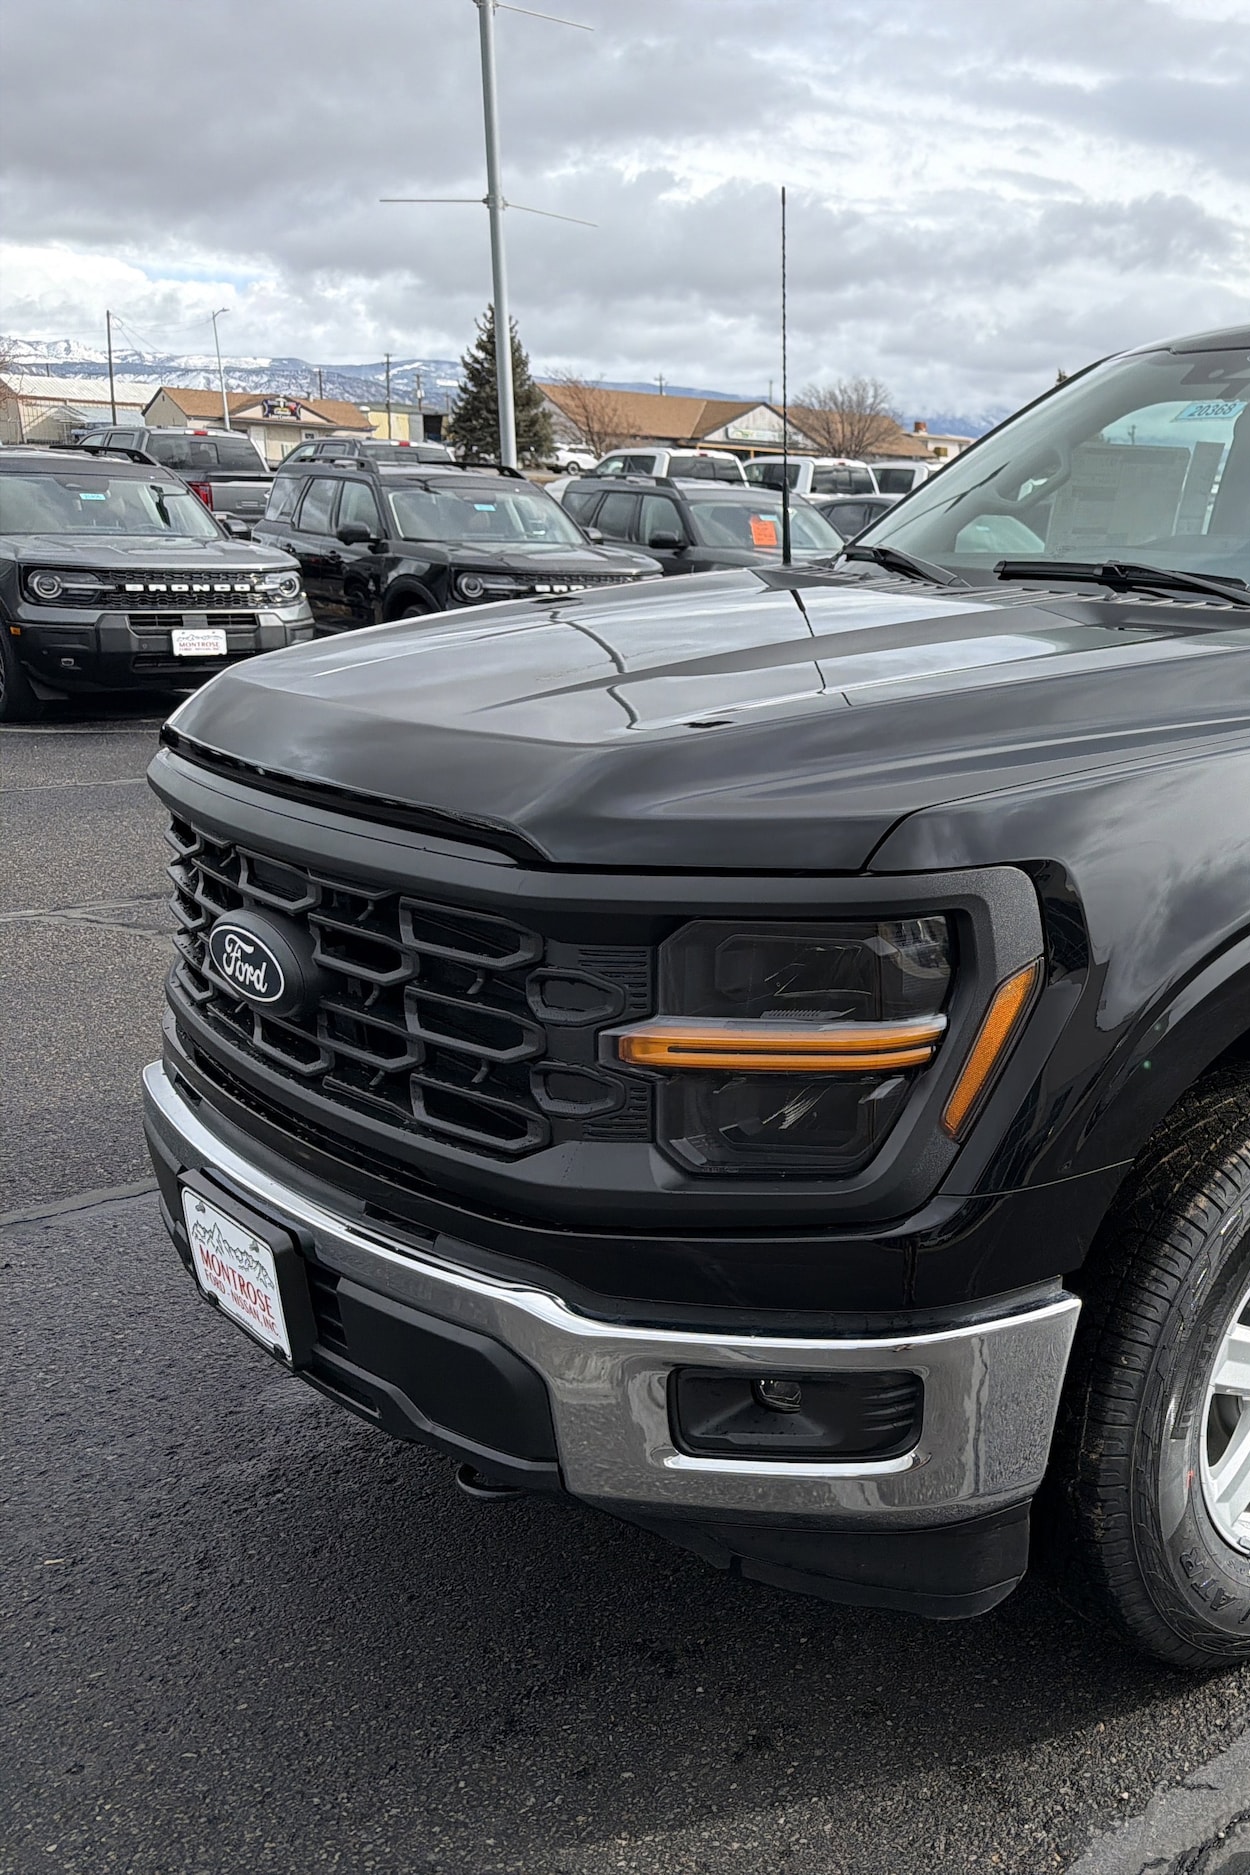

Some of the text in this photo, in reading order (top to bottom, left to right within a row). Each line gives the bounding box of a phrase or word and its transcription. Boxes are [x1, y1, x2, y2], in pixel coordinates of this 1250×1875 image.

[1187, 403, 1237, 417] 20368
[125, 584, 251, 592] BRONCO
[222, 933, 269, 994] Ford
[200, 1243, 275, 1320] MONTROSE
[205, 1269, 226, 1295] FORD
[1180, 1547, 1238, 1612] ATR
